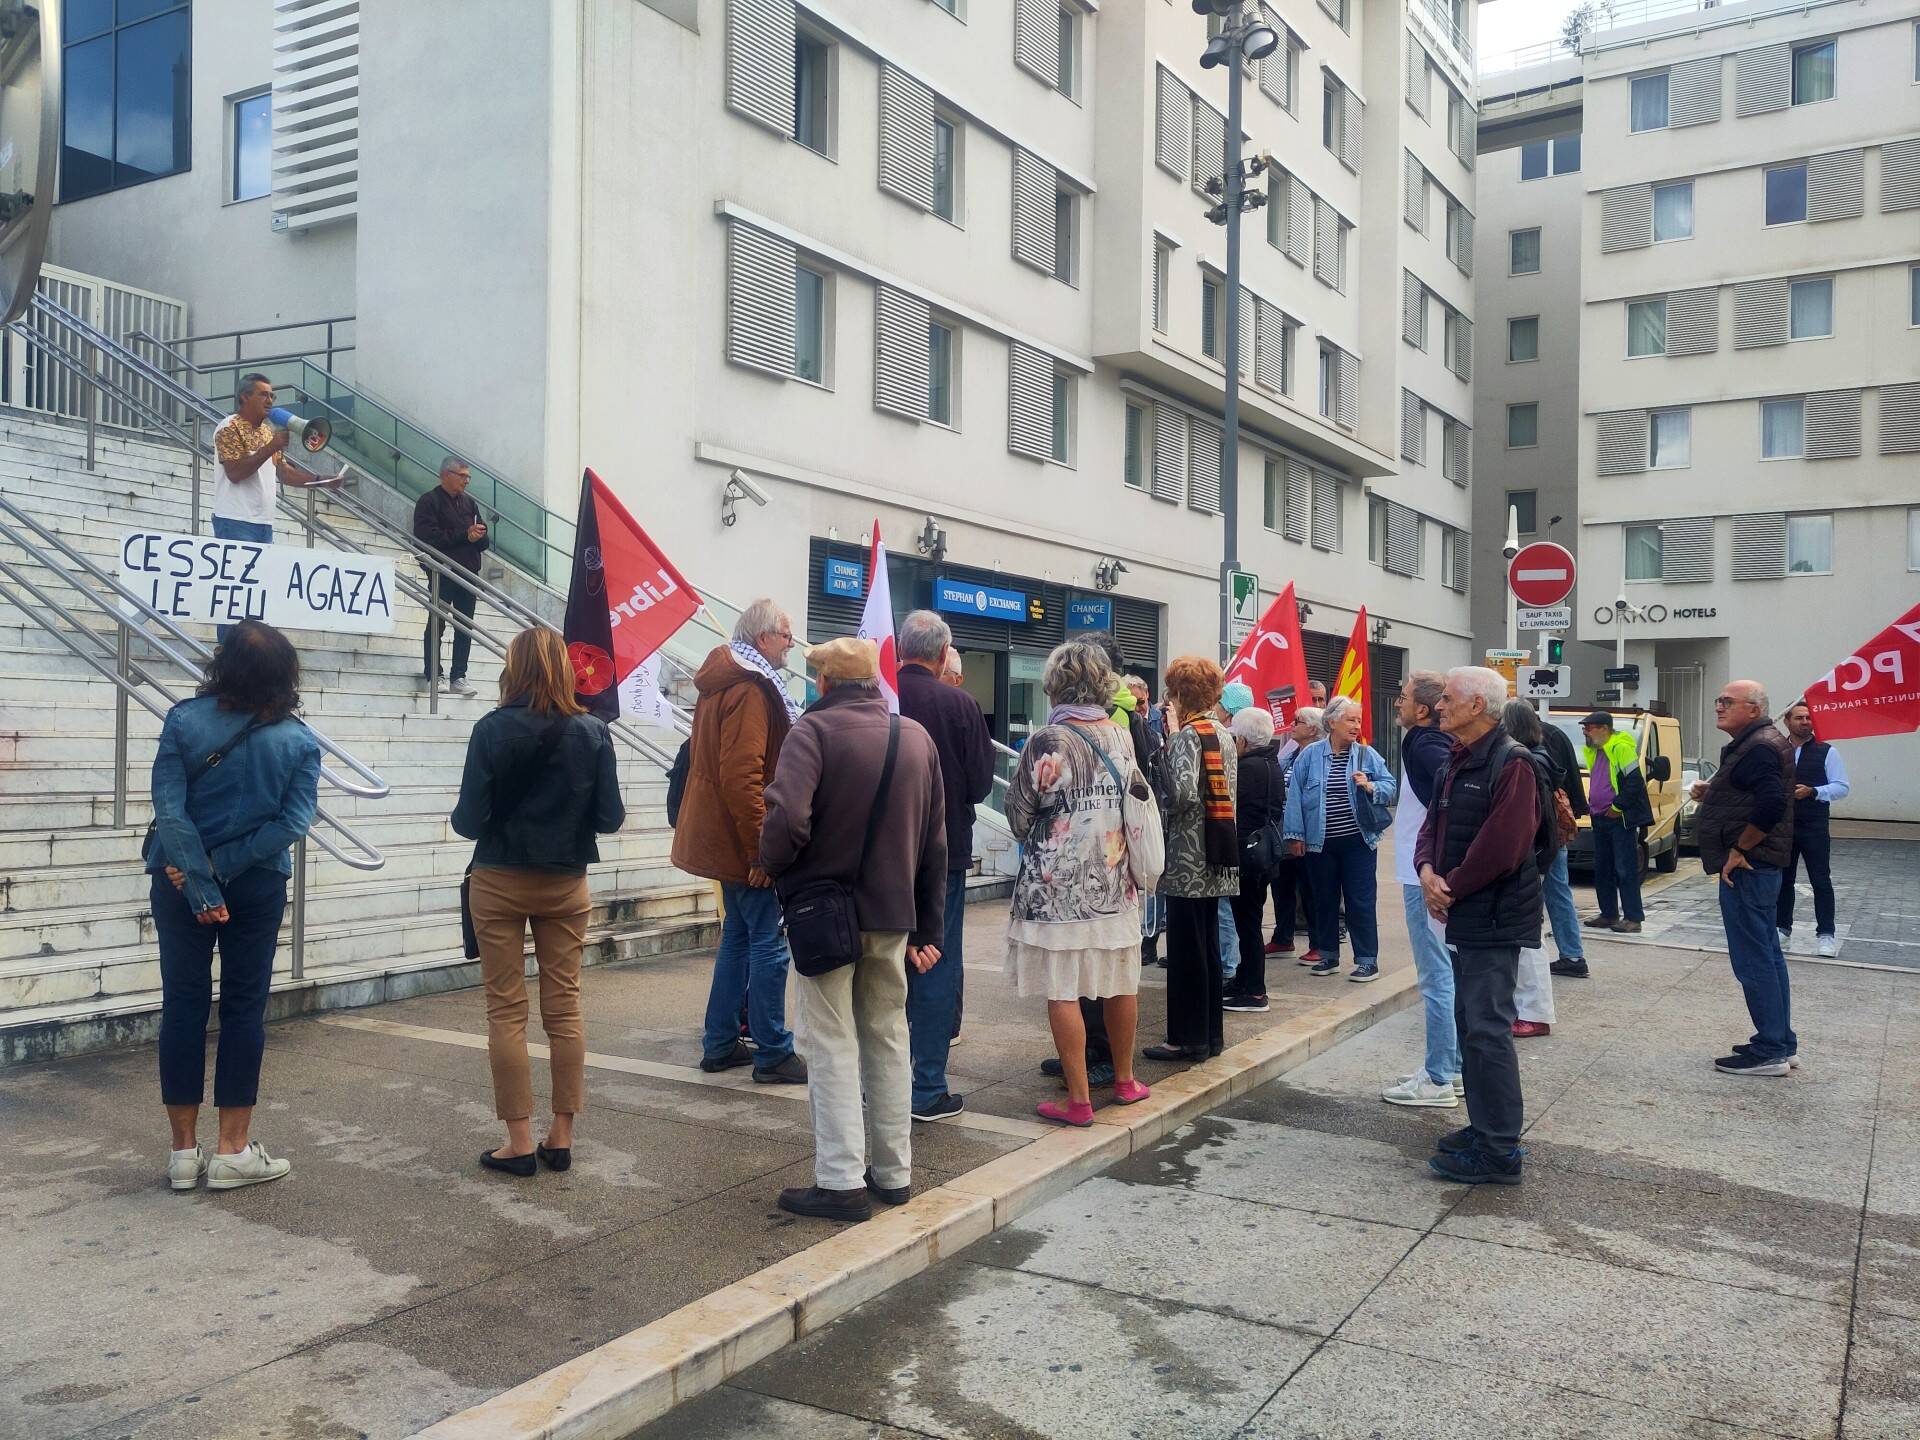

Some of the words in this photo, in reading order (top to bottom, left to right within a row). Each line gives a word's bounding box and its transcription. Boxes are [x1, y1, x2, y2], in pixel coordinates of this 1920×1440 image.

[123, 533, 263, 584] CESSEZ
[833, 565, 859, 577] CHANGE
[833, 580, 847, 590] ATM
[151, 579, 193, 616] LE
[209, 585, 267, 621] FEU
[943, 589, 974, 604] STEPHAN
[989, 597, 1022, 611] EXCHANGE
[1071, 604, 1105, 614] CHANGE
[1673, 608, 1717, 618] HOTELS
[1078, 799, 1102, 812] LIKE
